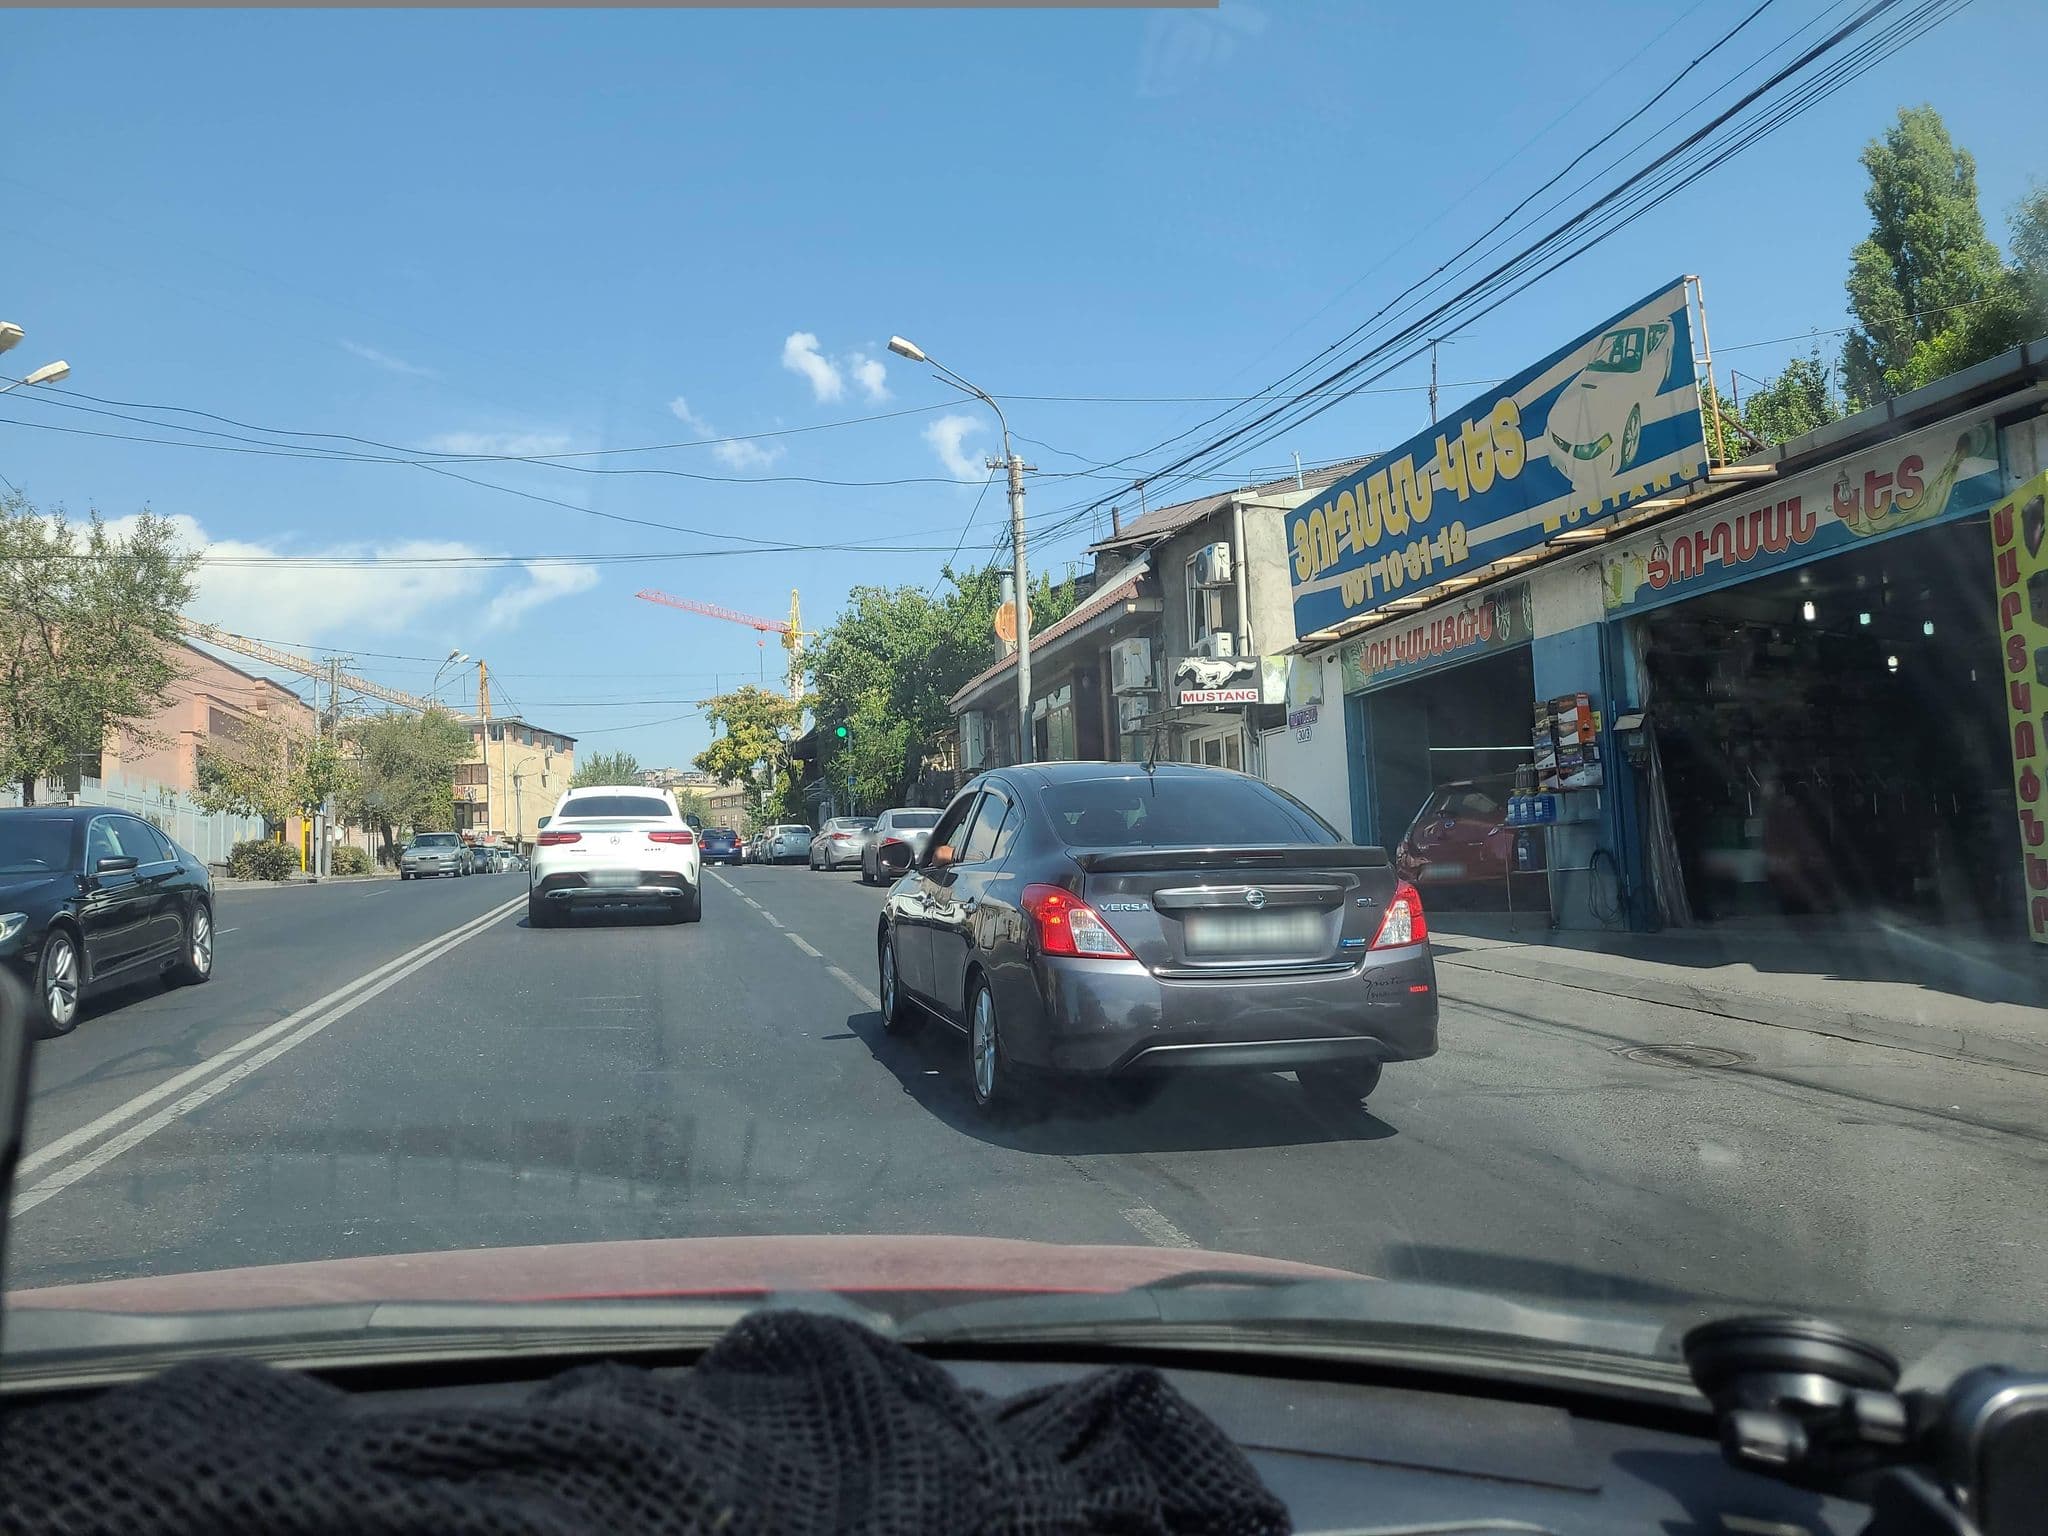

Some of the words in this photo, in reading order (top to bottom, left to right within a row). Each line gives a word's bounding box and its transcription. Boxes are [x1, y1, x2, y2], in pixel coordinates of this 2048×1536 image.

[1435, 396, 1527, 503] ԿԵՏ
[1183, 691, 1257, 703] MUSTANG
[1100, 903, 1151, 912] VERSA
